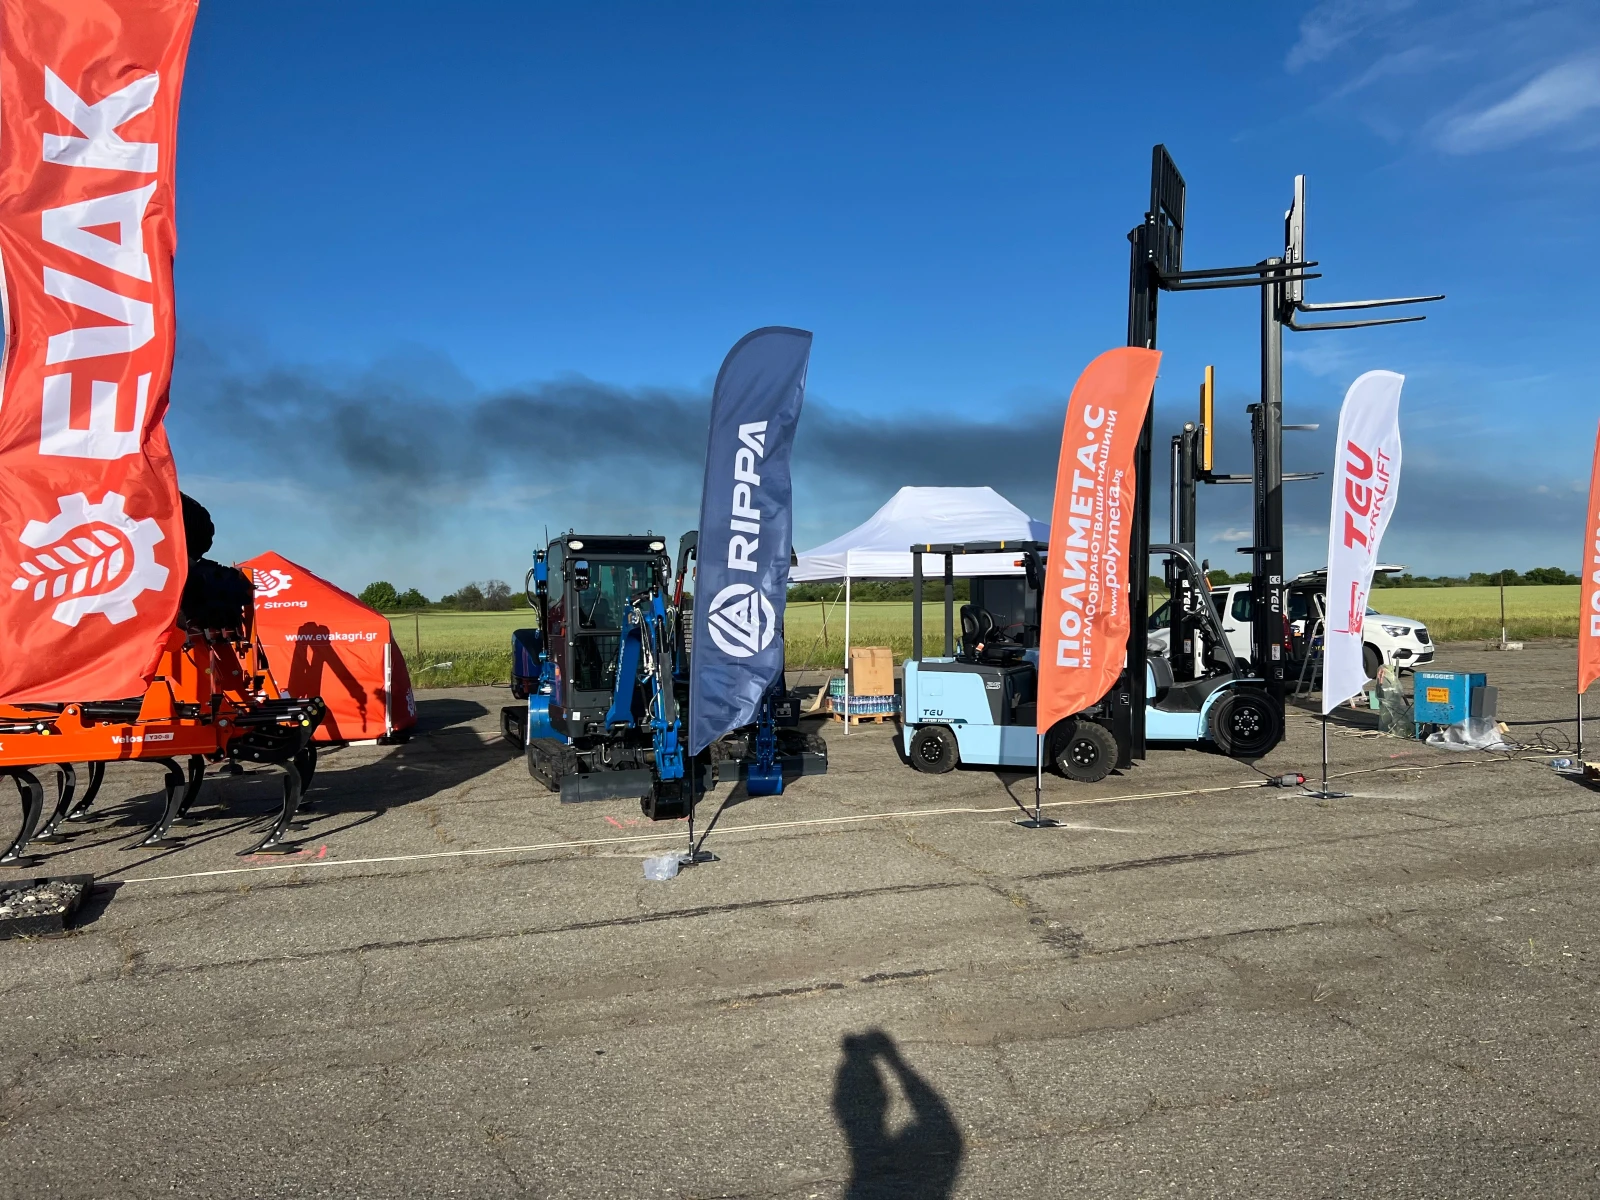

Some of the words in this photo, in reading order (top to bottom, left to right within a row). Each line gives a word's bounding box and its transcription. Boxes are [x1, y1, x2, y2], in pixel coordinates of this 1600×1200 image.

[39, 65, 160, 460] EVAK
[1097, 409, 1118, 482] МАШИНИ
[727, 420, 768, 573] RIPPA
[1343, 439, 1374, 550] TEU
[264, 601, 308, 610] Strong
[1270, 588, 1280, 613] TEU
[285, 631, 378, 642] www.evakagri.gr
[111, 735, 143, 744] Velos
